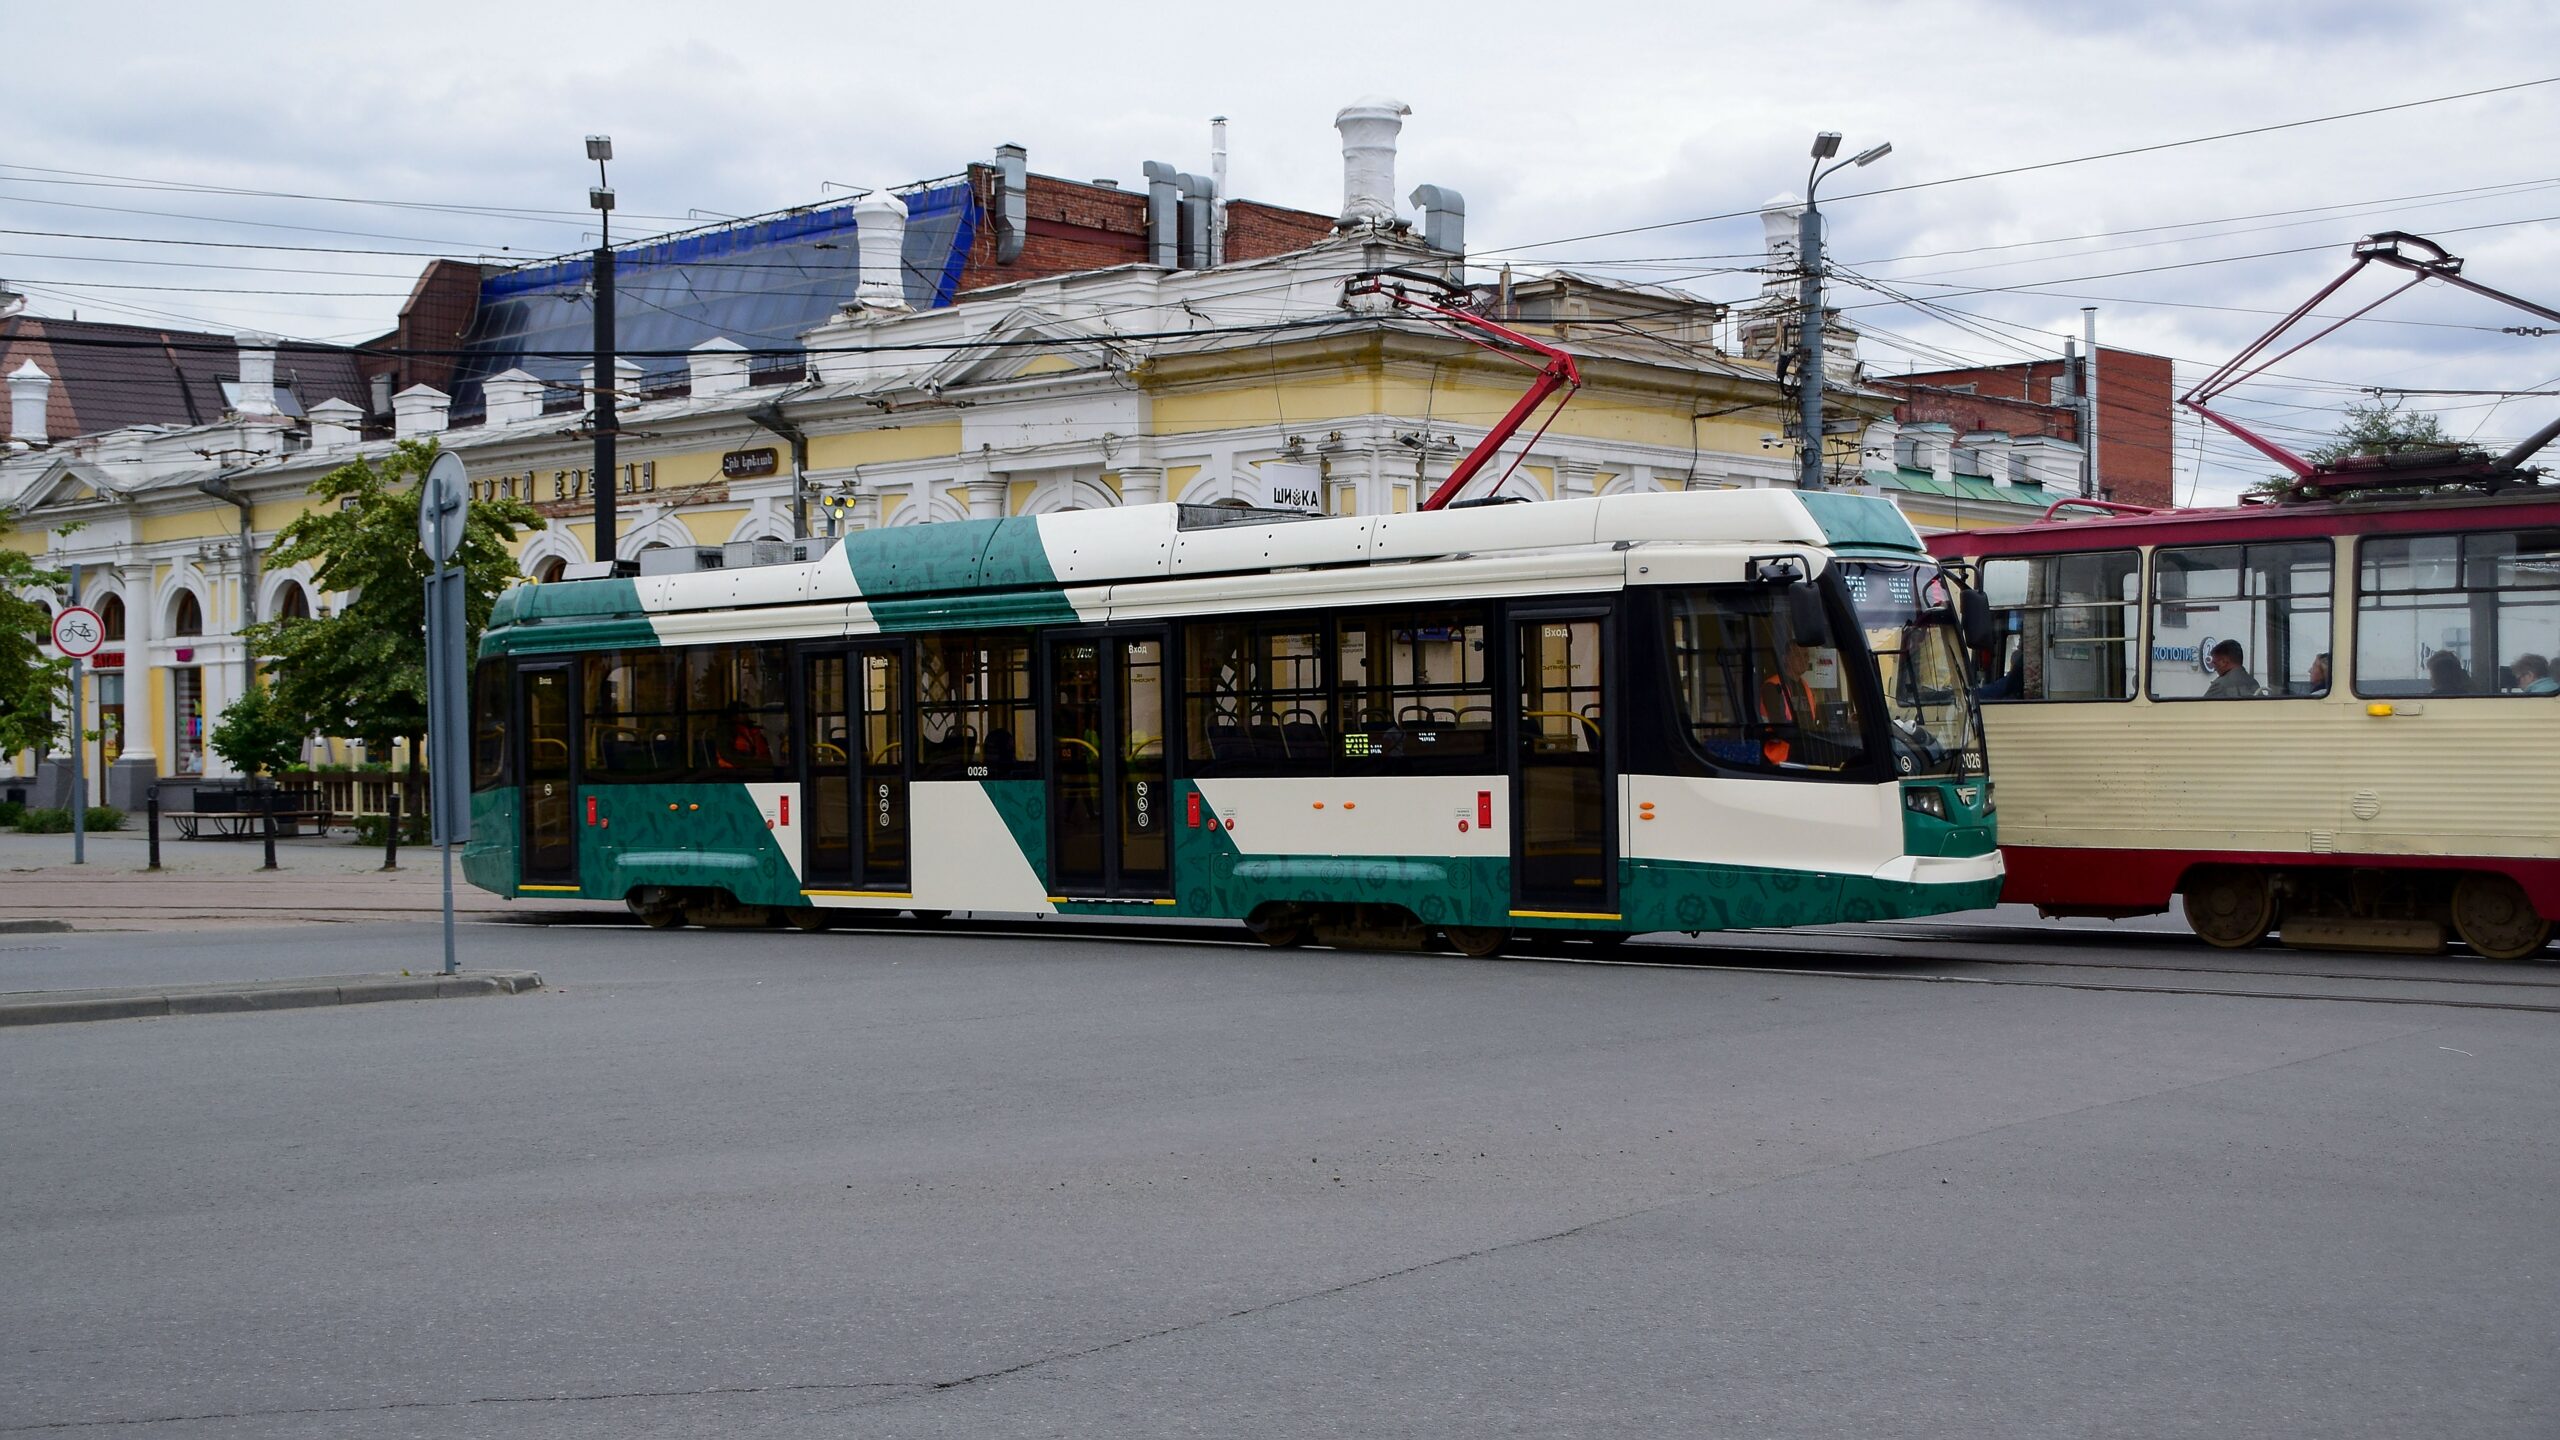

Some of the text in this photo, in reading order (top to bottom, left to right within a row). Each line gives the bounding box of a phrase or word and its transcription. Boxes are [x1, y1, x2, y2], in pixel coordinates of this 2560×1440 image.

[555, 460, 653, 499] ЕРЕАН
[1544, 628, 1568, 638] Вход
[1128, 644, 1147, 654] Вход
[967, 766, 988, 776] 0026
